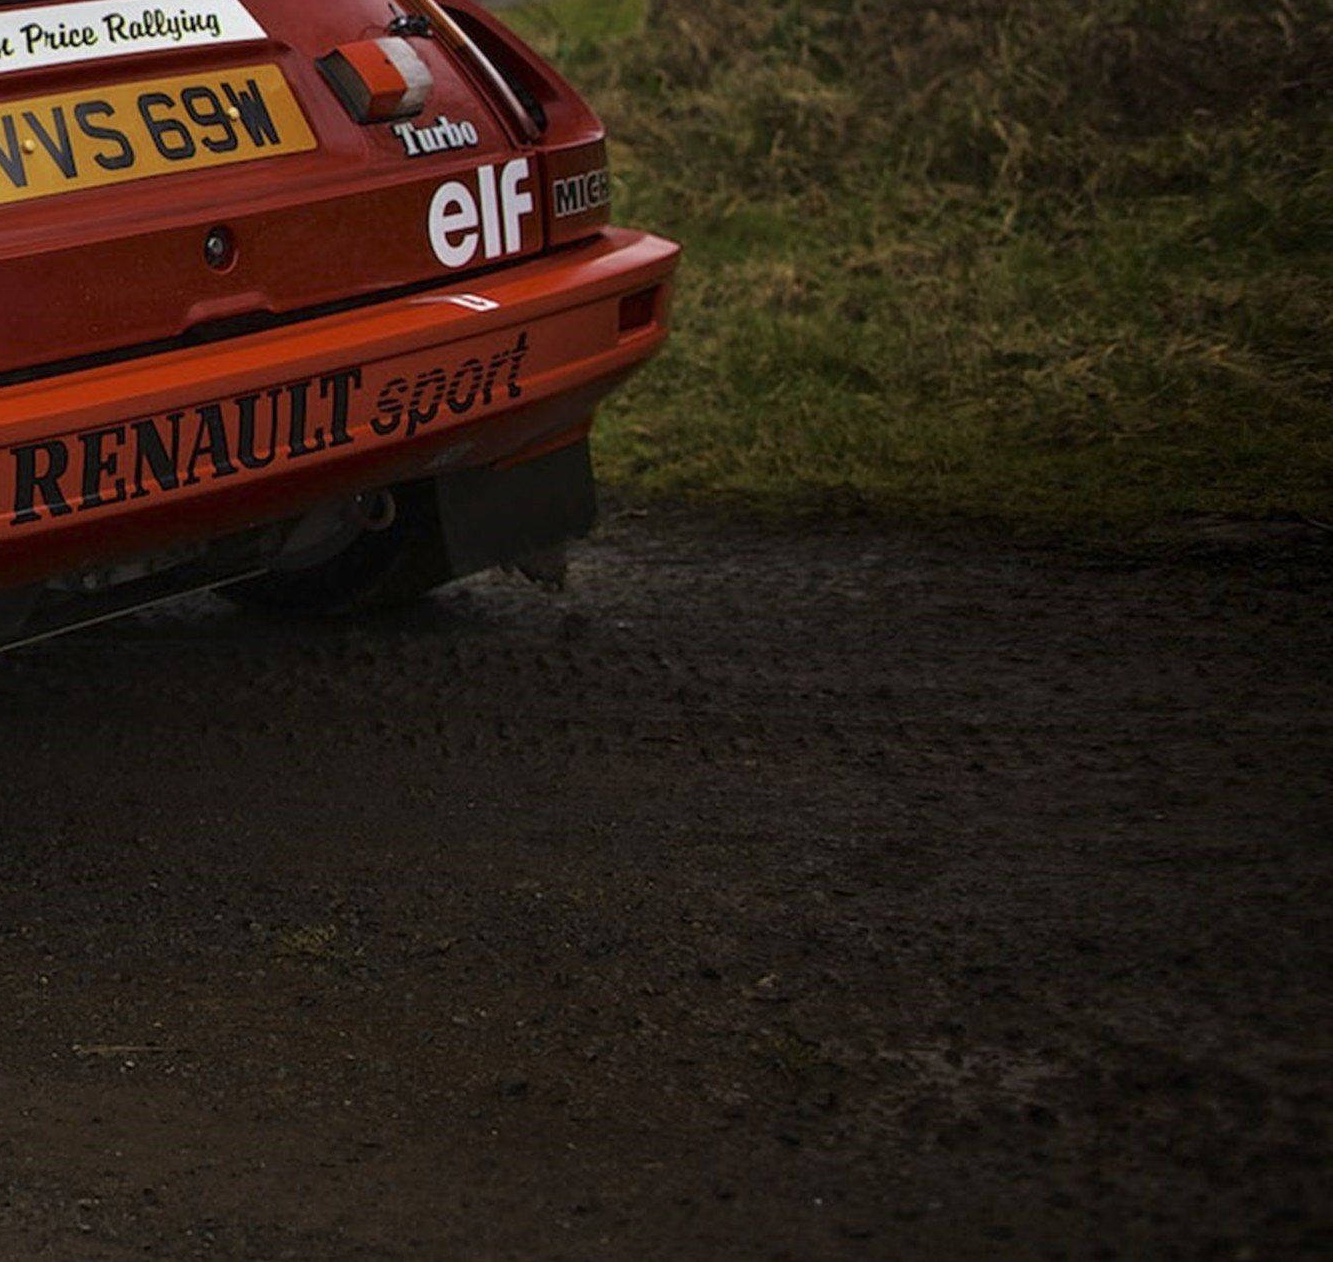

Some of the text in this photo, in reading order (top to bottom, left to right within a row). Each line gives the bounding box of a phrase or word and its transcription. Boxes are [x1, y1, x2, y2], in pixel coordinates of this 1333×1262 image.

[20, 22, 98, 54] Price
[102, 9, 221, 41] Rallying
[136, 79, 281, 161] 69W
[394, 116, 478, 156] Turbo
[429, 158, 532, 267] elf
[10, 332, 528, 526] RENAULT sport
